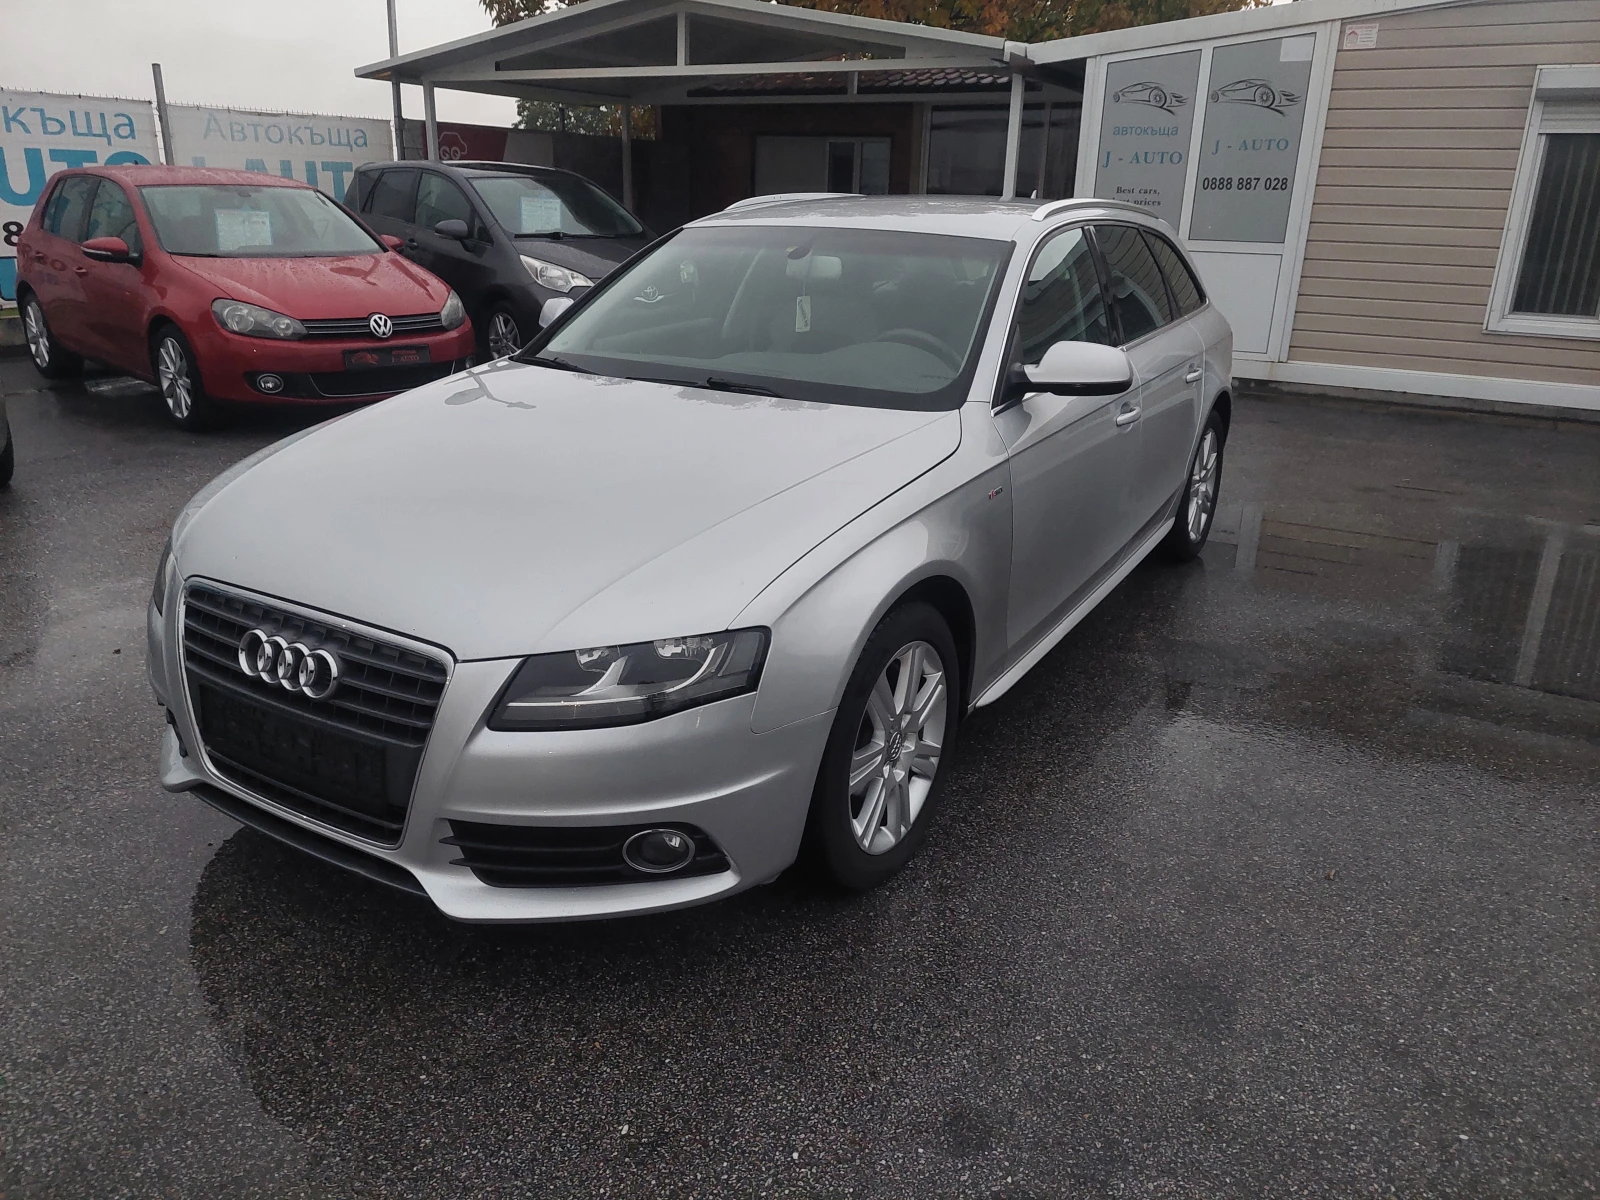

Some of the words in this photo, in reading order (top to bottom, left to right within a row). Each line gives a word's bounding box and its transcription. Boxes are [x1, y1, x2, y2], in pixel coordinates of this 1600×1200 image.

[1, 105, 137, 147] къща
[202, 112, 369, 152] Автокъща
[1112, 125, 1179, 138] автокъща
[1211, 139, 1221, 156] J
[1238, 138, 1290, 152] AUTO
[1102, 150, 1112, 168] J
[1129, 150, 1183, 165] AUTO
[1116, 186, 1135, 194] Best
[1139, 188, 1160, 196] cars,
[1202, 177, 1234, 191] 0888
[1236, 177, 1261, 191] 887
[1264, 177, 1289, 191] 028
[2, 221, 24, 247] 8
